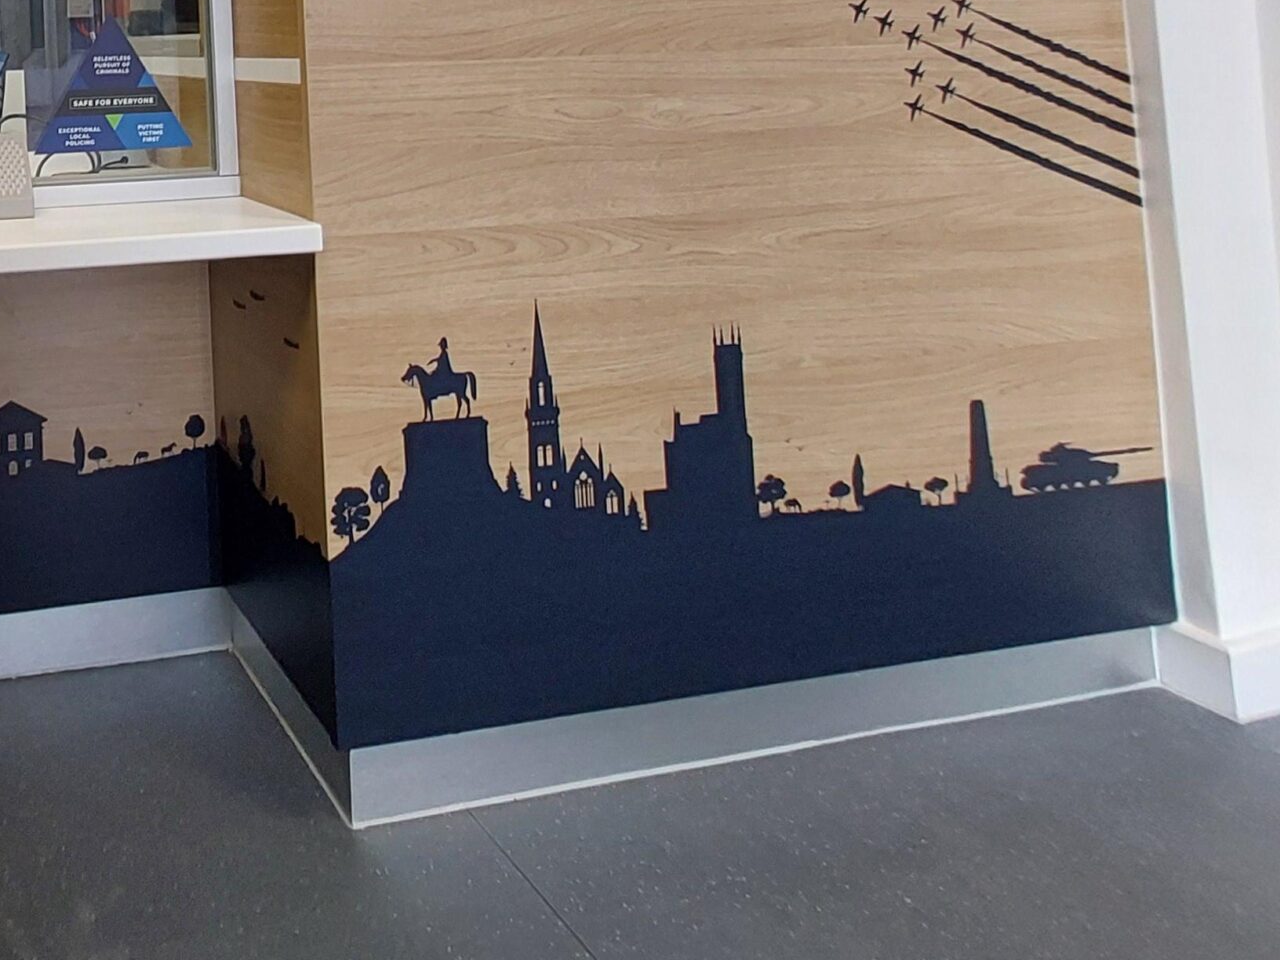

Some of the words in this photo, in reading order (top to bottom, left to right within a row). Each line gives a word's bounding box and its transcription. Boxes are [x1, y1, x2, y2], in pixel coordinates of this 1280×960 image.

[73, 99, 93, 107] SAFE
[95, 98, 111, 106] FOR
[113, 97, 154, 106] EVERYONE
[58, 126, 101, 134] EXCEPTIONAL
[65, 139, 95, 147] POLICING
